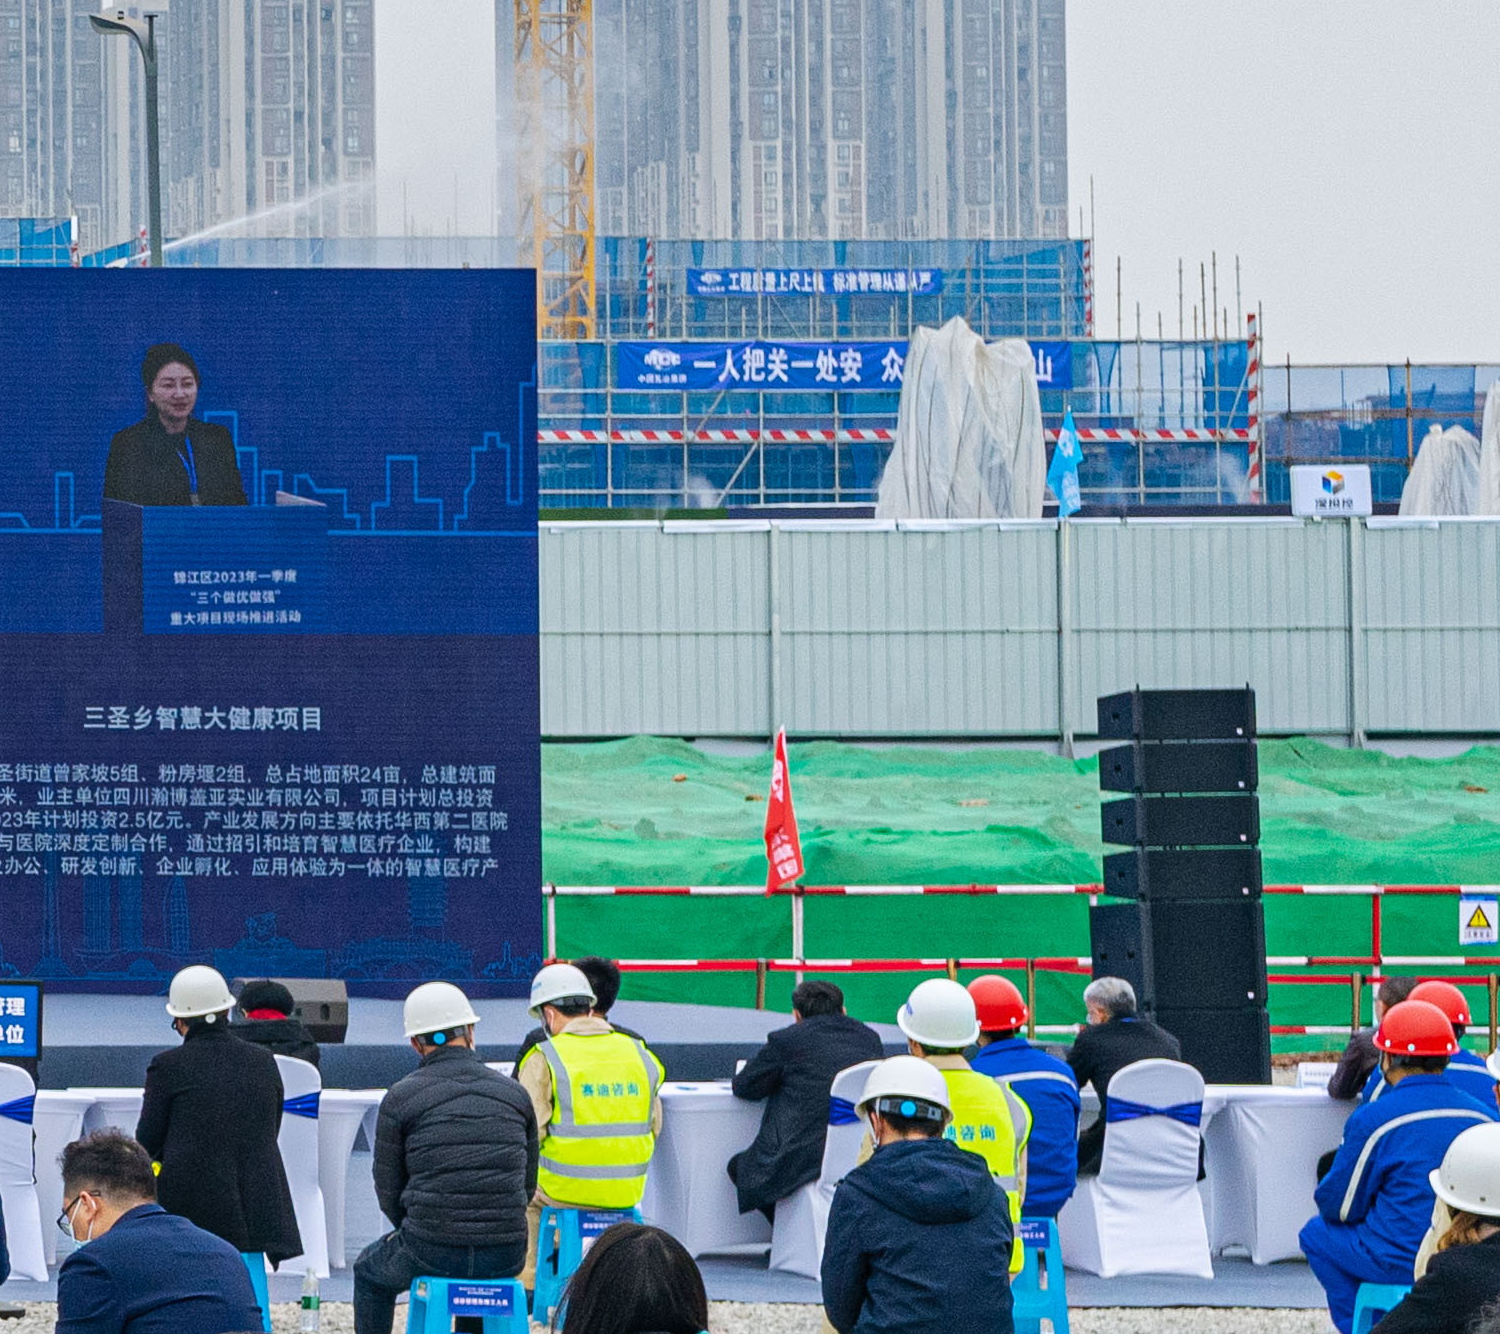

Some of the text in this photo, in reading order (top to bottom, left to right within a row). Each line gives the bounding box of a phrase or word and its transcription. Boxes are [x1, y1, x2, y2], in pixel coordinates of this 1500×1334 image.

[693, 348, 863, 384] 一人把关一处安
[173, 569, 297, 585] 锦江区2023年一季度
[169, 609, 301, 626] 重大项目现场推进活动
[83, 707, 322, 732] 三圣乡智慧大健康项目
